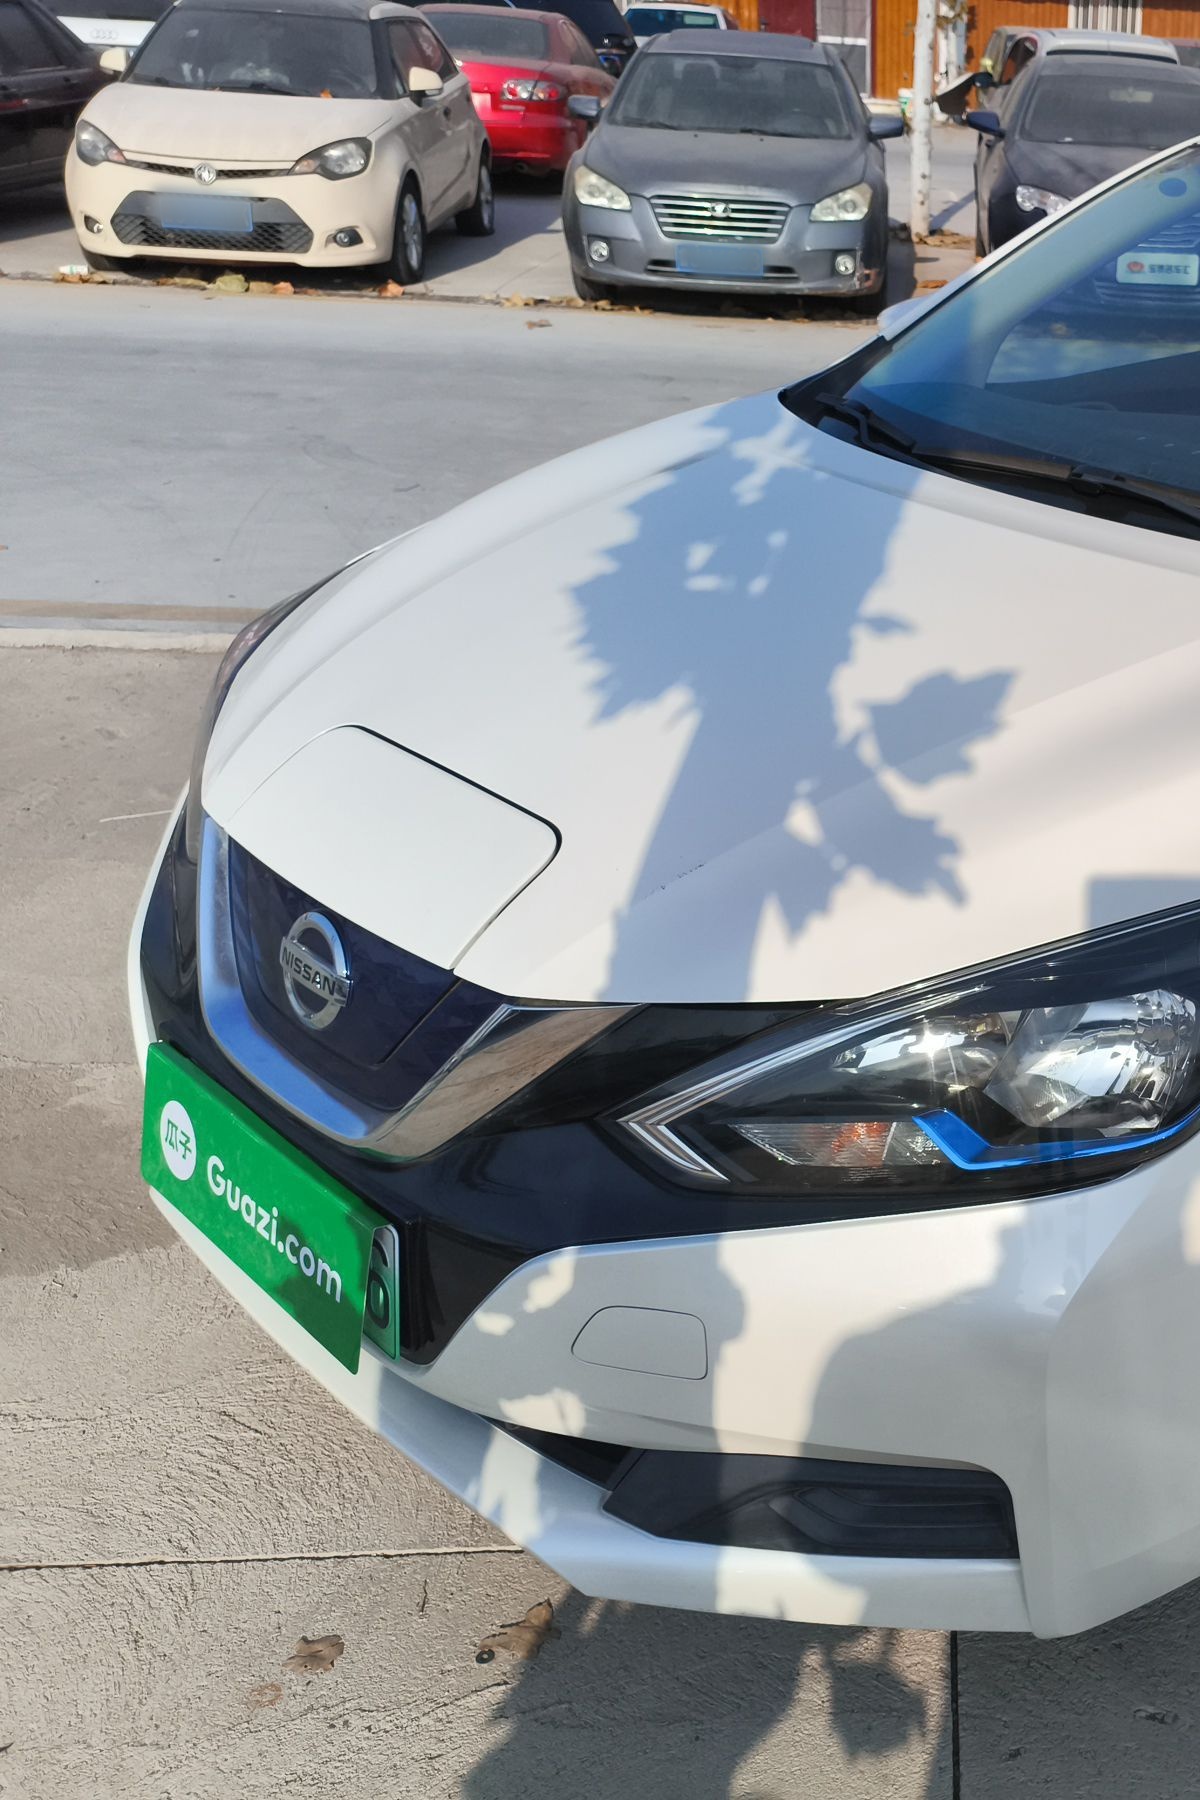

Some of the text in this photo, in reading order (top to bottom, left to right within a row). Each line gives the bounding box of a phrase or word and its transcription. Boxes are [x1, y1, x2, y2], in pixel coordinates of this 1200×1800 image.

[281, 946, 337, 997] NISSAN
[165, 1118, 192, 1160] 瓜子
[206, 1155, 343, 1303] Guazi.com
